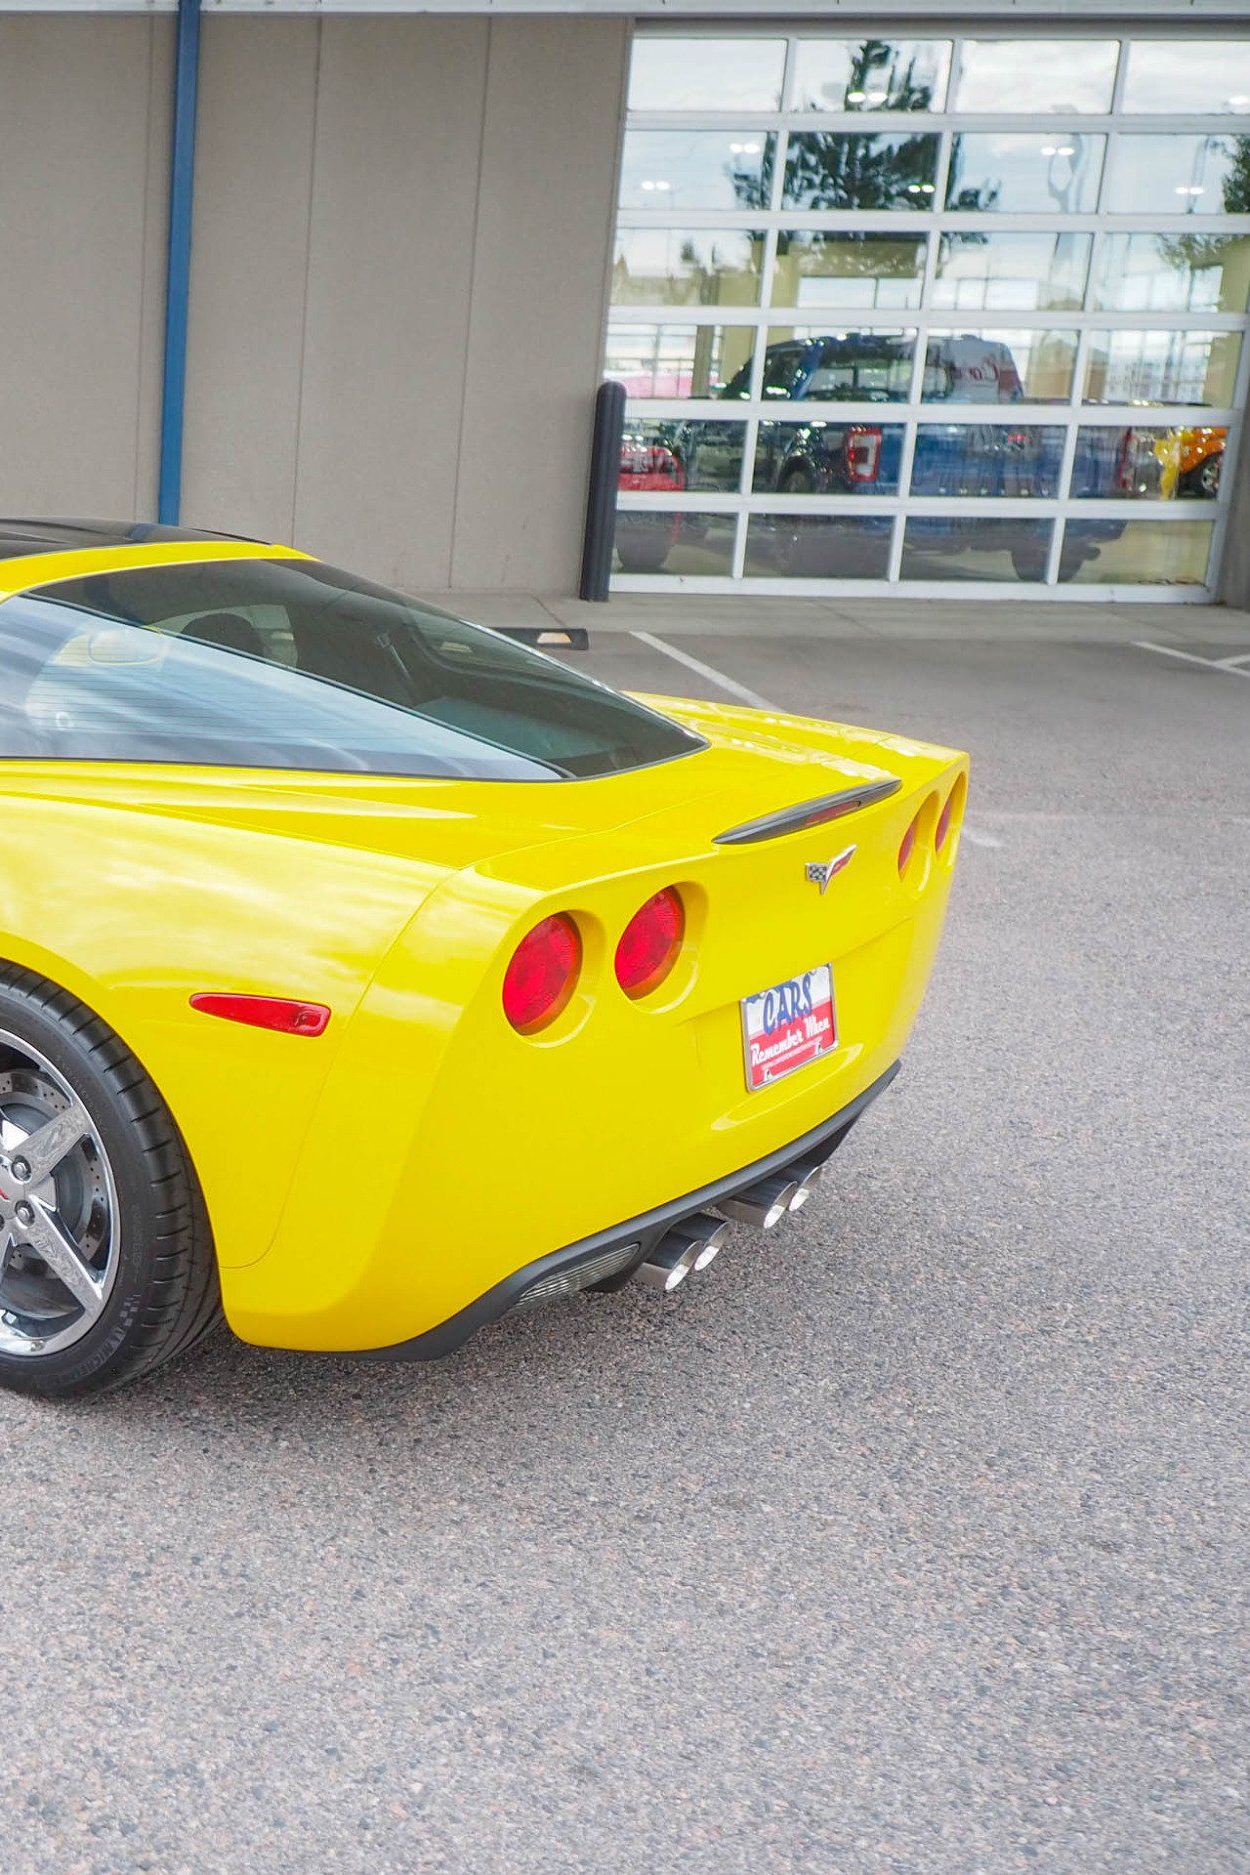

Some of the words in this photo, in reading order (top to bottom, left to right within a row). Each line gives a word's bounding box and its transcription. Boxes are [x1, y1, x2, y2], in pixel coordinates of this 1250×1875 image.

[763, 974, 813, 1035] CARS
[751, 1028, 804, 1066] Remember
[804, 1014, 831, 1038] When
